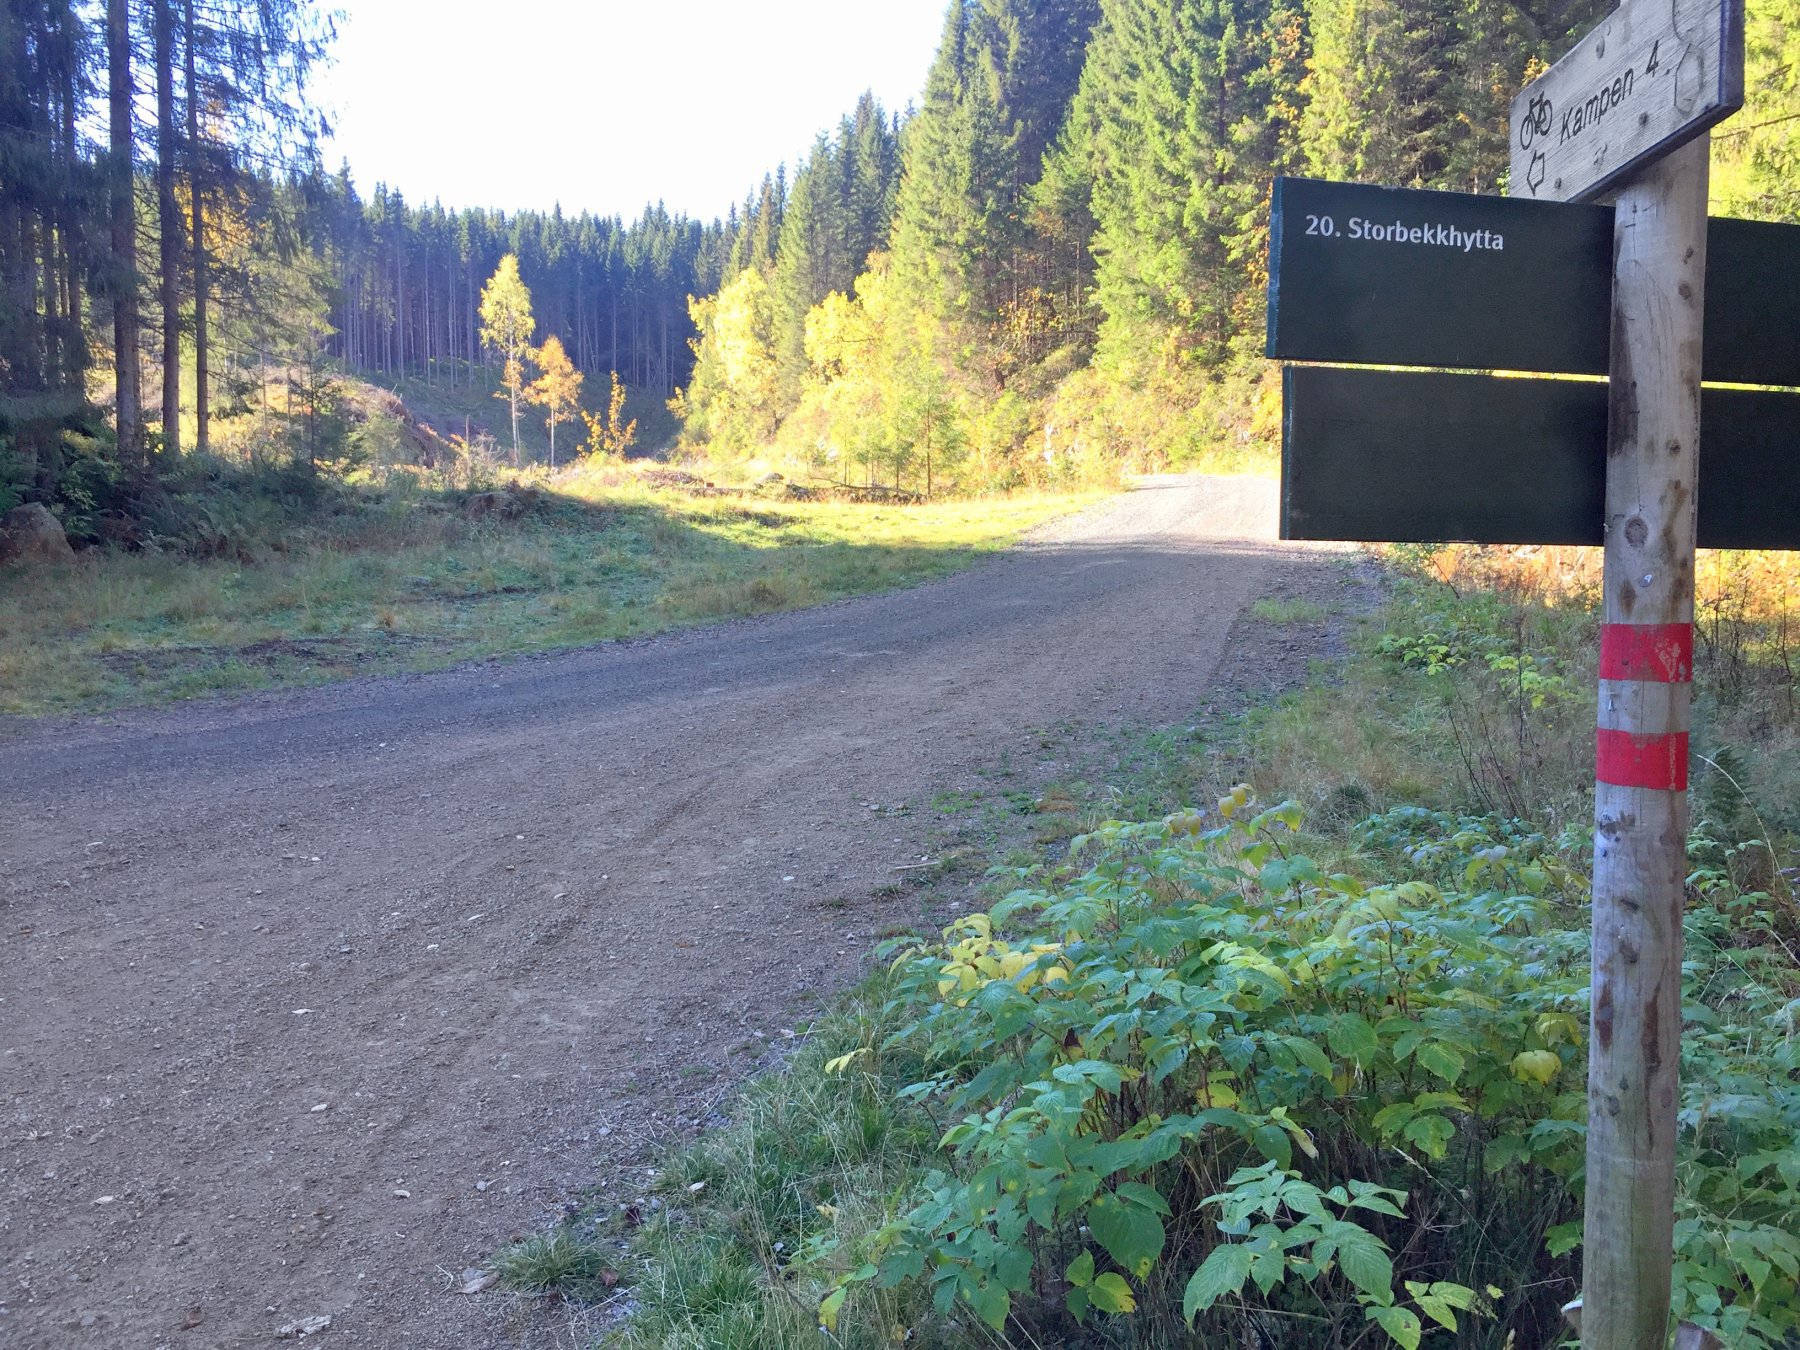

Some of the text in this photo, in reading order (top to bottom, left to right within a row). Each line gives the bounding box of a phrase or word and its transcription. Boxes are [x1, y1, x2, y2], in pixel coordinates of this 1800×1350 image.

[1559, 68, 1634, 146] Kampen
[1305, 214, 1504, 252] 20. Storbekkhytta
